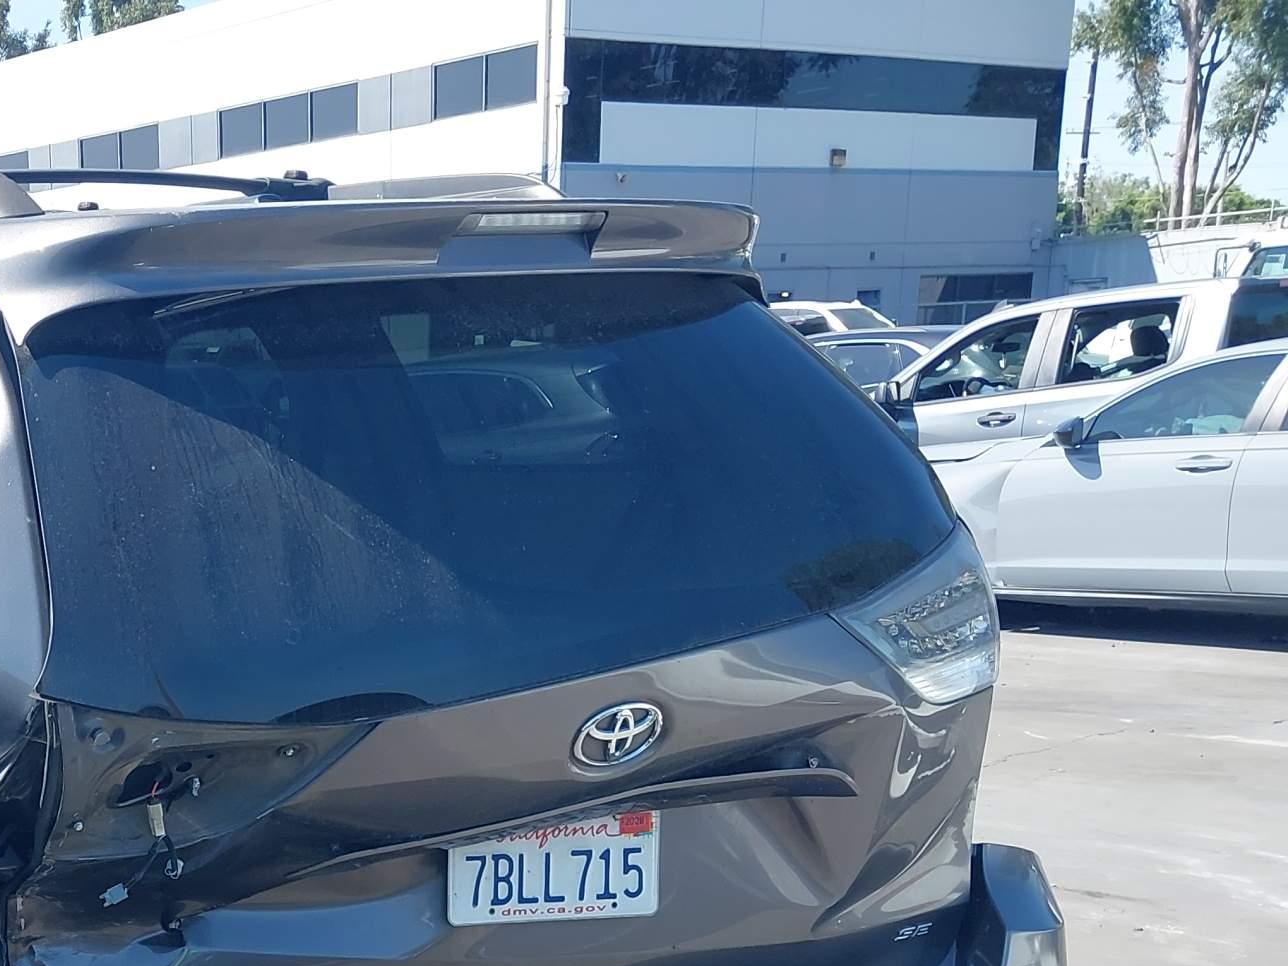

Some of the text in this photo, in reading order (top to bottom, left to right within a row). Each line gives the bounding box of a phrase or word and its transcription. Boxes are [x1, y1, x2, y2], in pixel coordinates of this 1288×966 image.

[496, 822, 621, 849] aifornia
[465, 847, 644, 908] 7BLL715
[501, 904, 607, 917] dmv.ca.gov
[894, 922, 933, 941] SE
